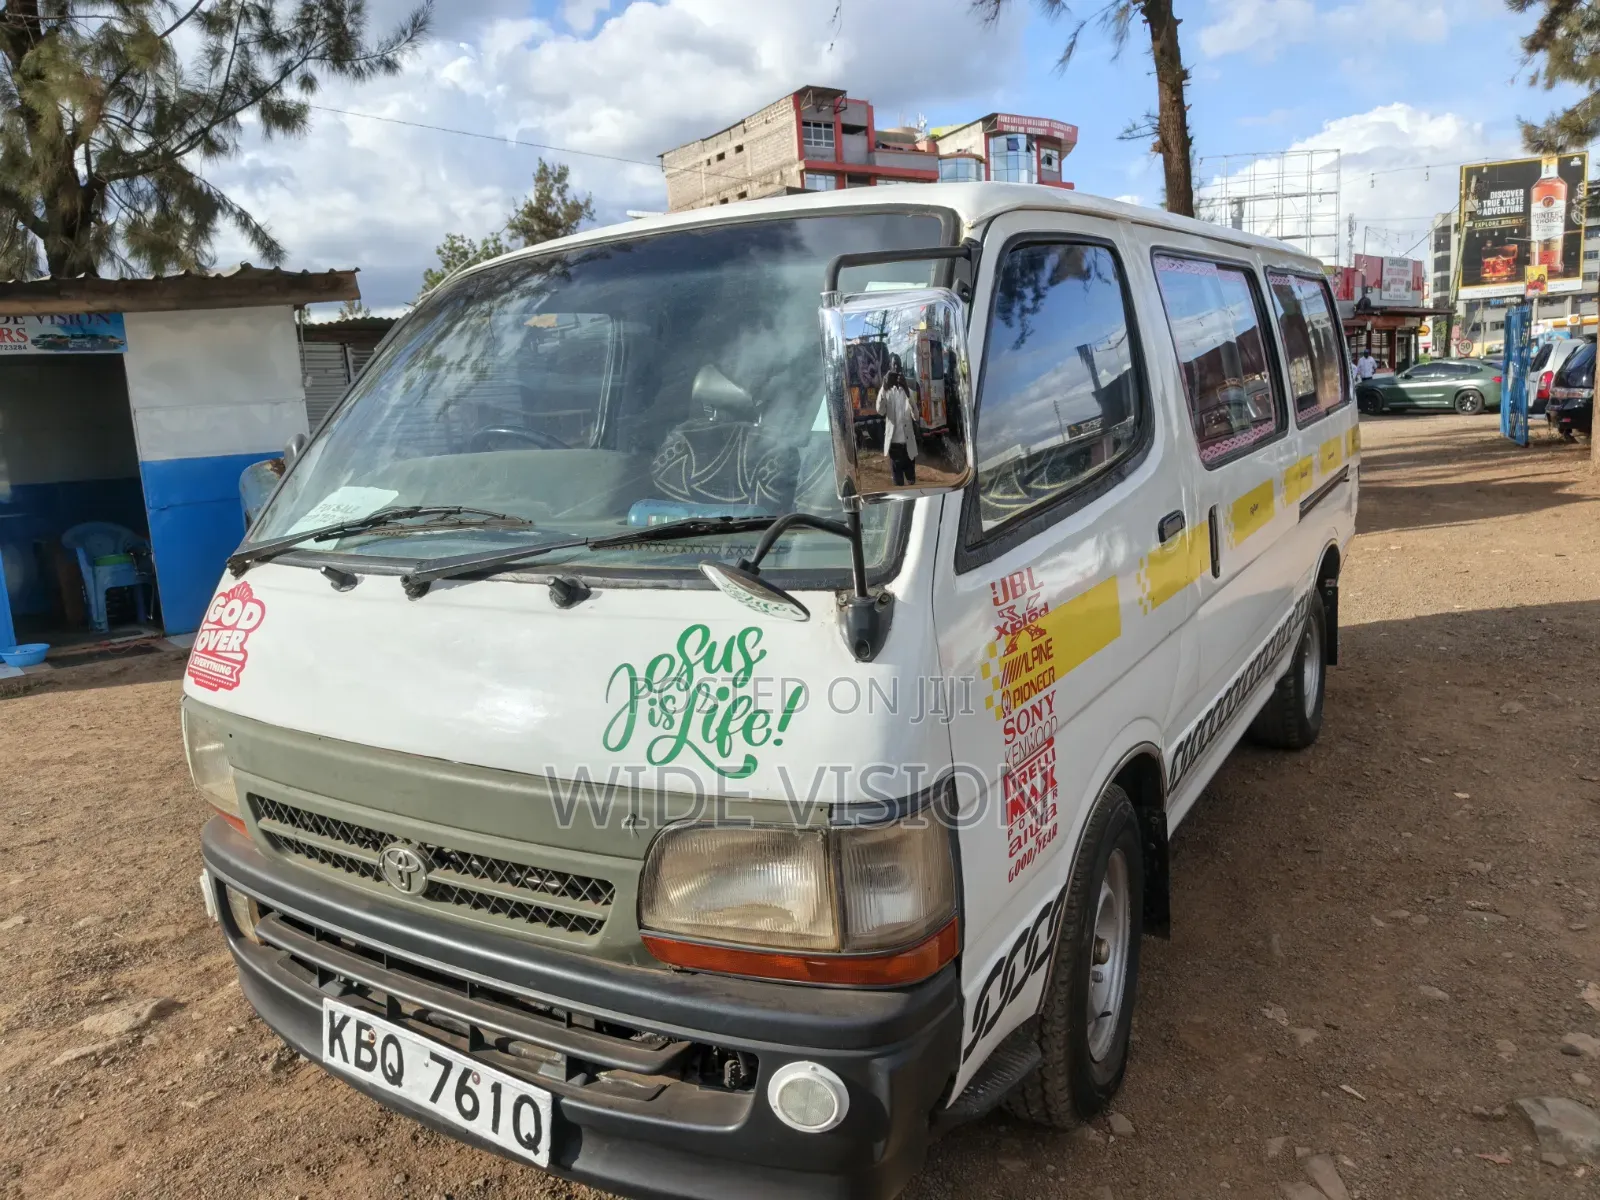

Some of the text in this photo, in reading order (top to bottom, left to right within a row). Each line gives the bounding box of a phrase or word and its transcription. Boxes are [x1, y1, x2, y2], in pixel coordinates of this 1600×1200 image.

[1483, 200, 1500, 208] TRUE
[1503, 197, 1524, 206] TASTE
[1483, 205, 1524, 216] ADVENTURE
[1490, 189, 1524, 199] DISCOVER
[1460, 342, 1471, 351] 50
[990, 567, 1044, 606] JBL
[208, 595, 262, 630] GOD
[196, 629, 246, 652] OVER
[602, 623, 767, 752] Jesus
[646, 682, 804, 779] Life!
[648, 694, 677, 730] is
[1003, 689, 1056, 746] SONY
[1005, 715, 1058, 770] KENWOOD
[1007, 788, 1058, 842] POWER
[1008, 823, 1058, 883] GOODYEAR
[328, 1010, 542, 1156] KBQ 761Q
